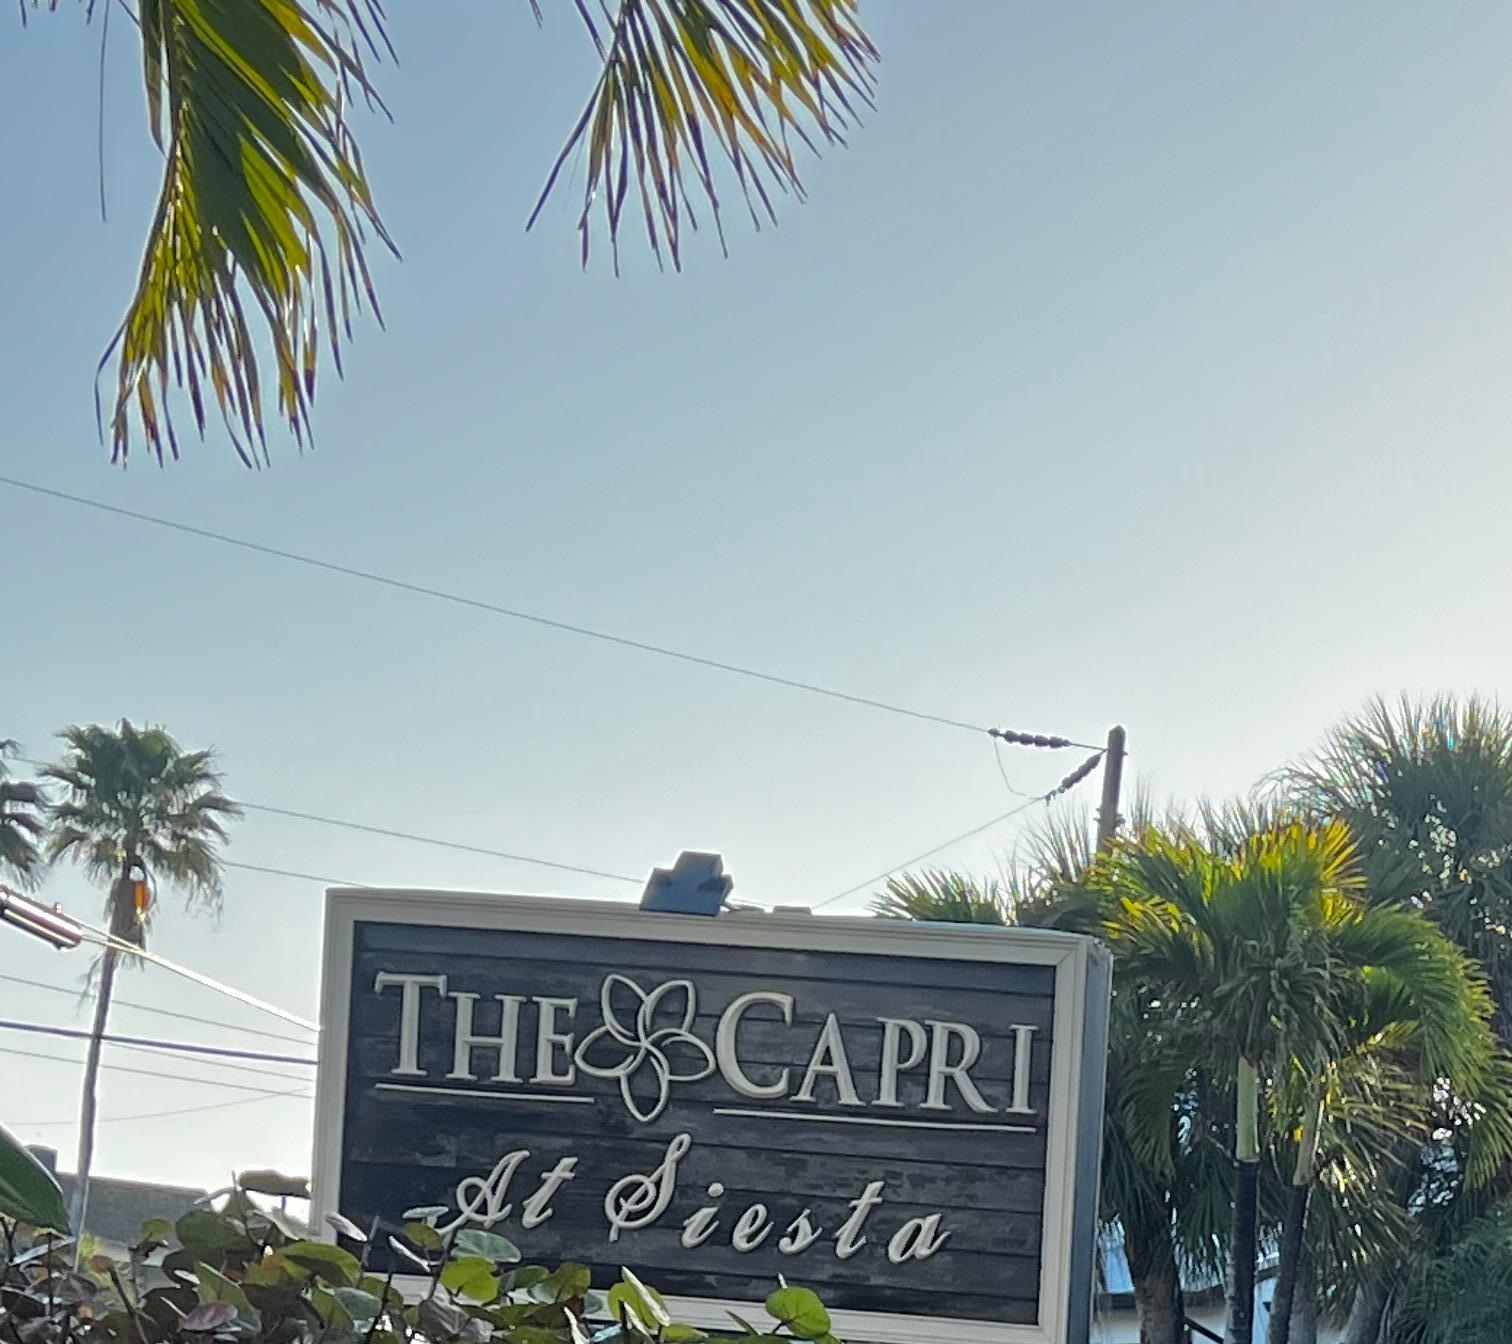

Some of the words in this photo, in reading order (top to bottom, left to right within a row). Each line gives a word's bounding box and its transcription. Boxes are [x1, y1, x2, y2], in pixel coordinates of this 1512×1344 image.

[374, 970, 578, 1086] THE
[715, 990, 1039, 1115] CAPRI
[433, 1150, 578, 1236] At
[604, 1133, 951, 1264] Siesta
